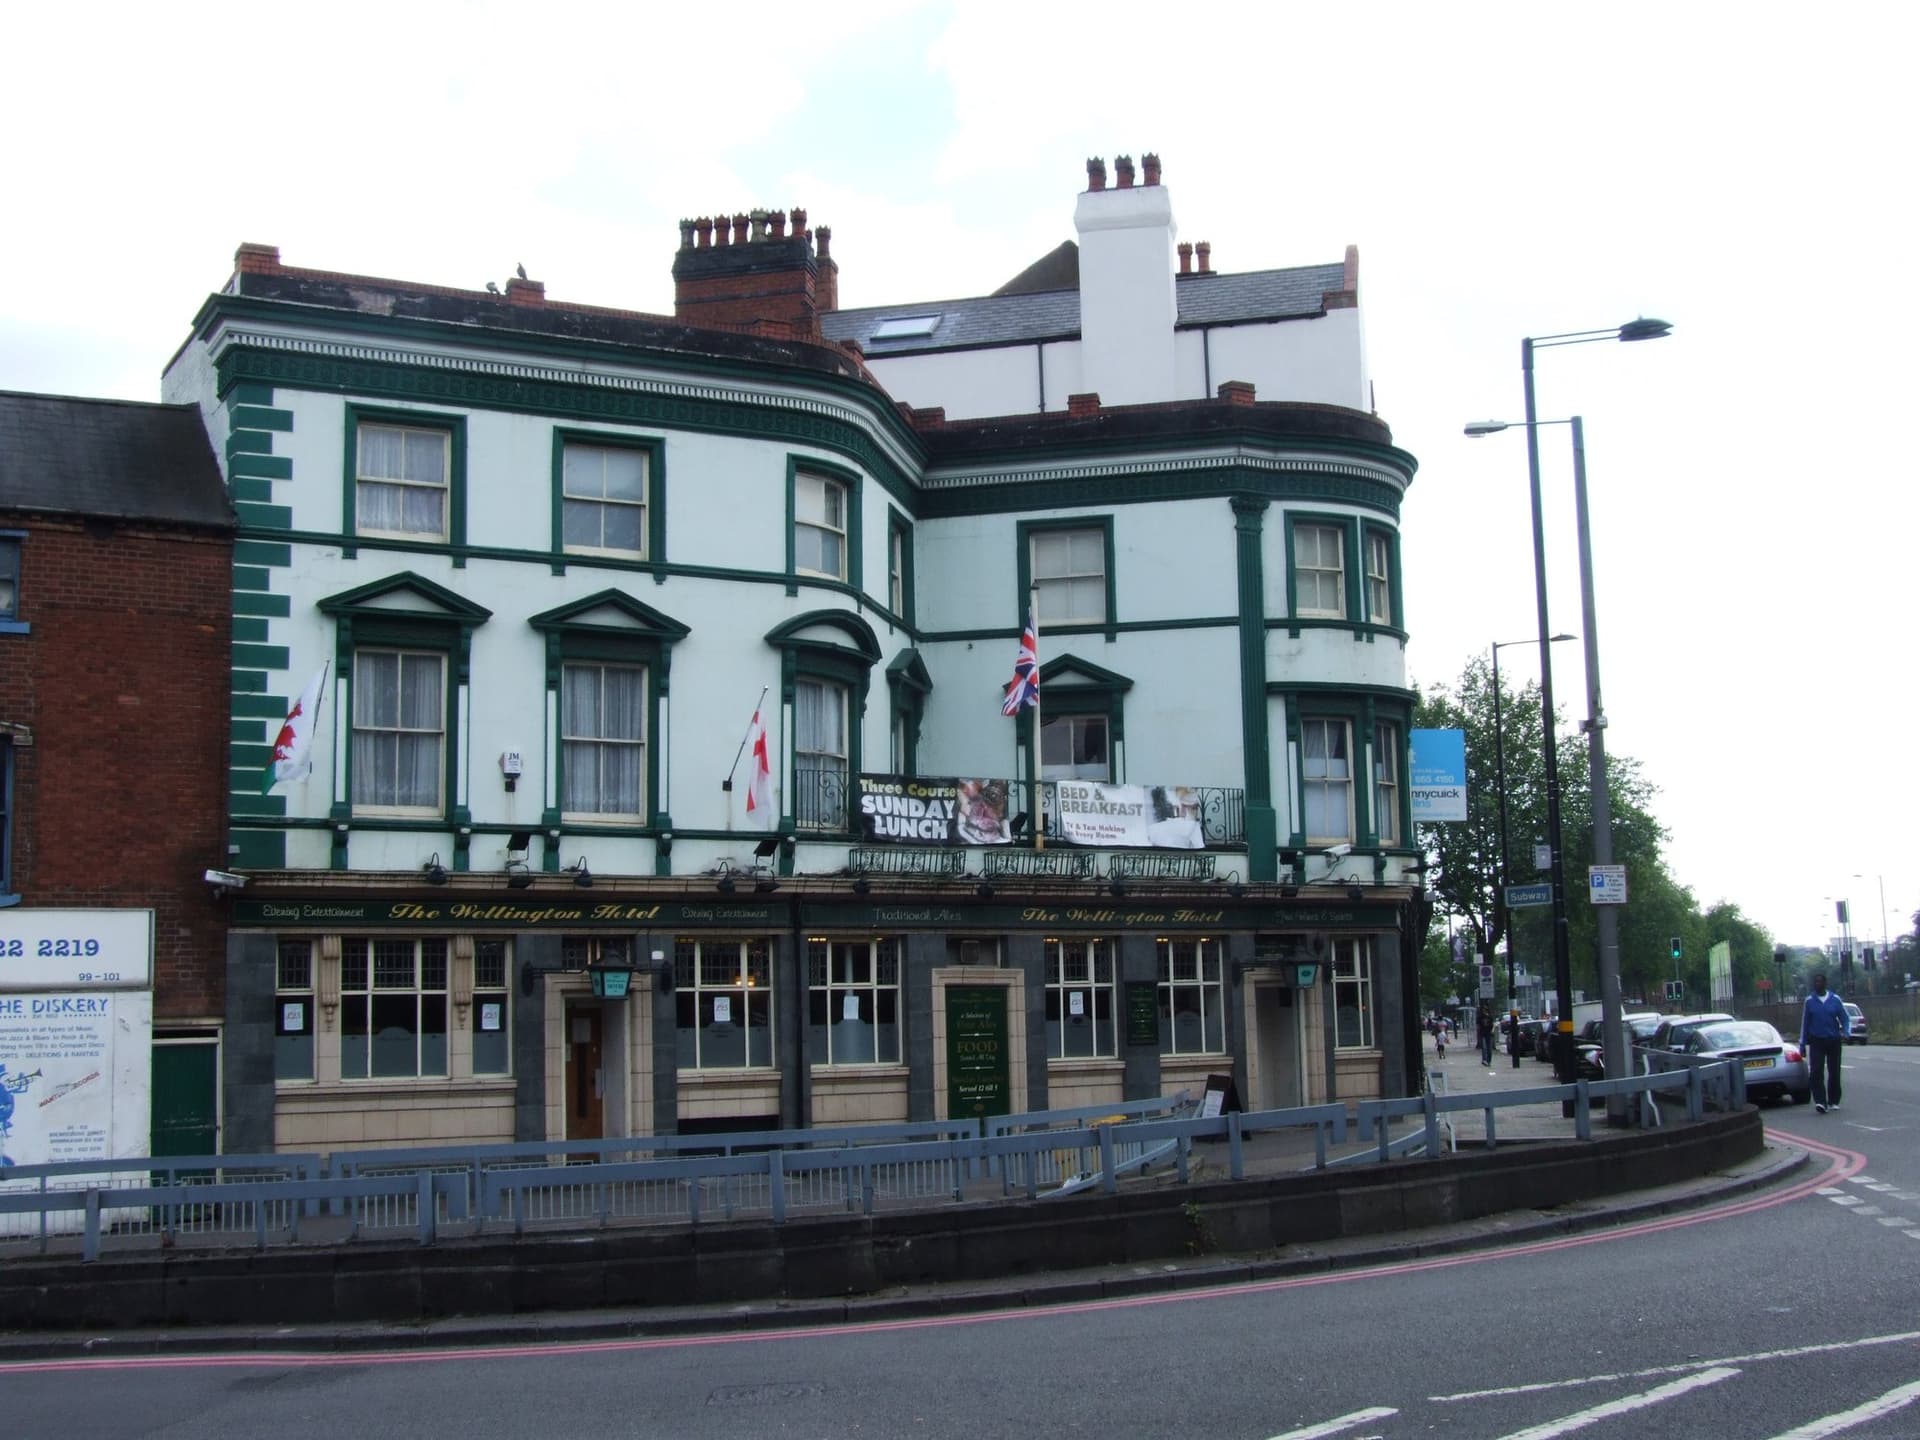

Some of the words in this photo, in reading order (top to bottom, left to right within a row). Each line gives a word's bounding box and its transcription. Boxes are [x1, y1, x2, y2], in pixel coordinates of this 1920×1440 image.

[860, 779, 903, 794] Three
[908, 783, 956, 798] Course
[1060, 787, 1089, 800] BED
[1094, 788, 1105, 801] &
[862, 794, 956, 819] SUNDAY
[1062, 801, 1143, 817] BREAKFAST
[874, 815, 948, 839] LUNCH
[1511, 892, 1547, 902] Subway
[263, 904, 300, 920] Evening
[303, 904, 365, 918] Entertainment
[388, 903, 441, 919] The
[450, 903, 582, 923] Wellington
[590, 903, 661, 920] Hotel
[872, 907, 931, 922] Traditional
[1021, 907, 1060, 922] The
[1066, 907, 1166, 926] Wellington
[1172, 908, 1224, 923] Hotel
[38, 939, 100, 957] 2219
[32, 998, 108, 1013] DISKERY
[957, 1041, 998, 1053] FOOD
